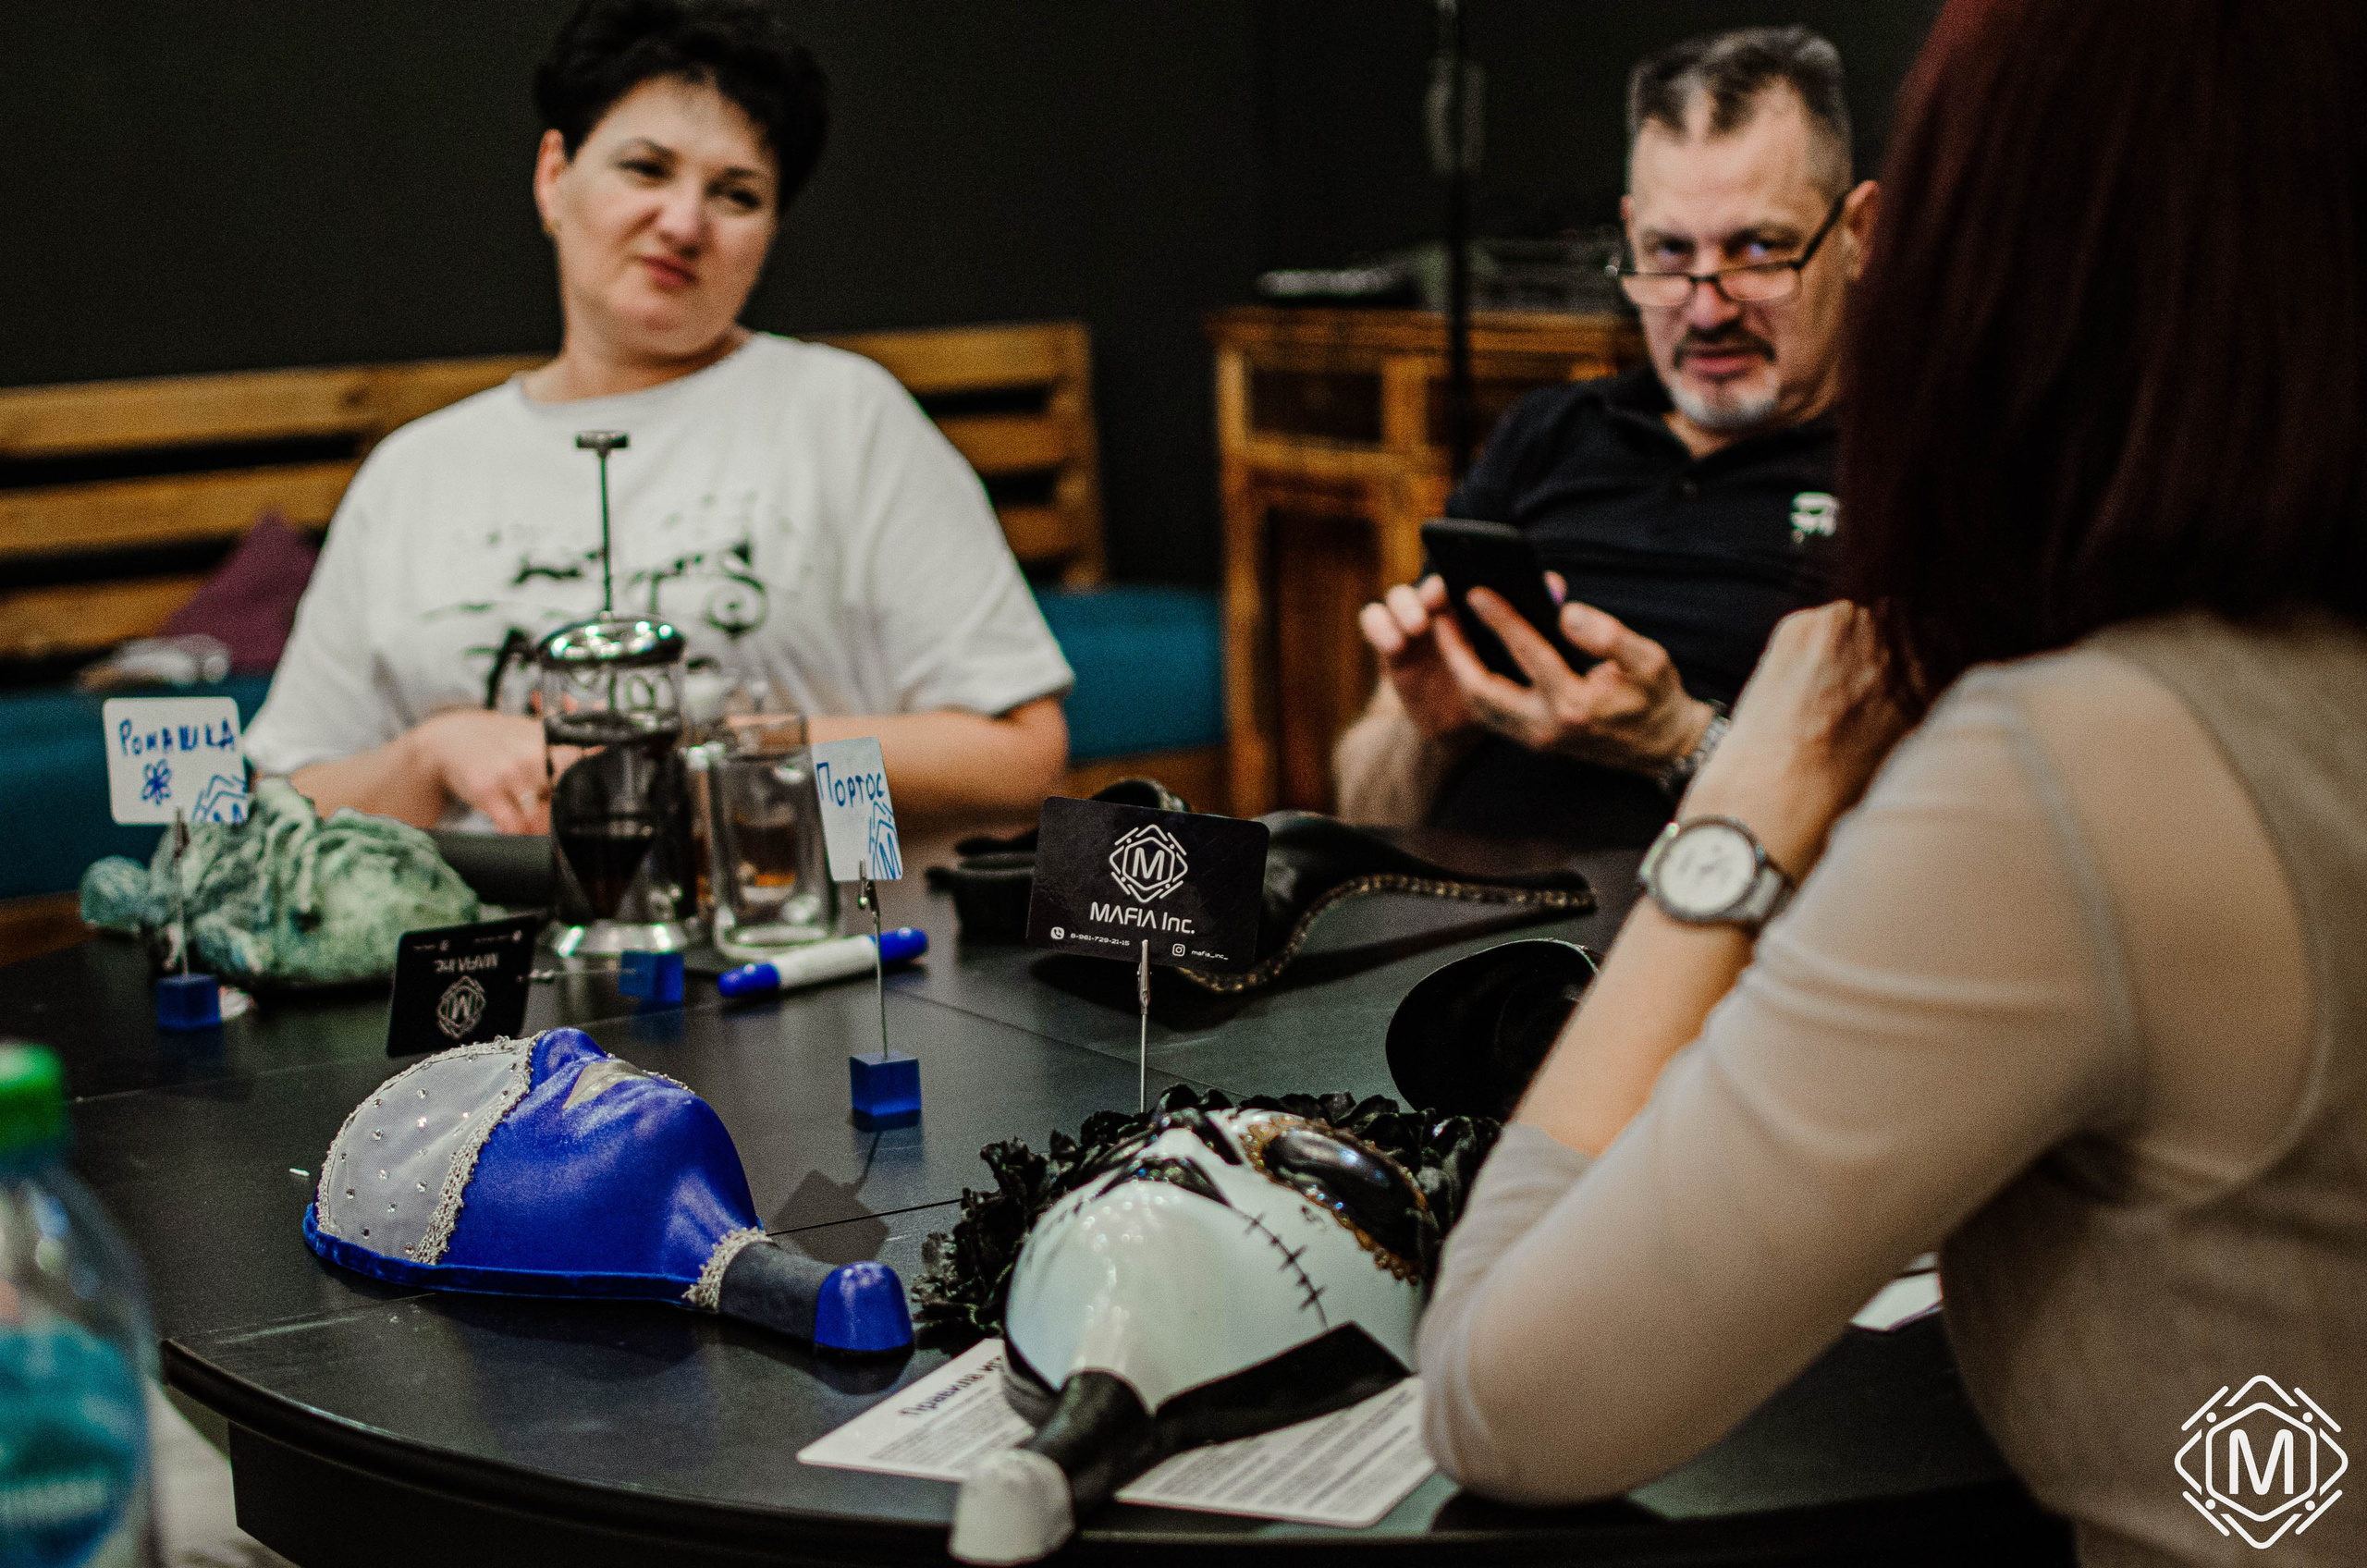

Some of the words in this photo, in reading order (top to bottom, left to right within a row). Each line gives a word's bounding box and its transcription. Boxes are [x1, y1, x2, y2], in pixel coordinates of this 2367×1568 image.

[1132, 847, 1165, 881] M
[1089, 901, 1157, 930] MAFIA
[1162, 912, 1196, 935] Inc.
